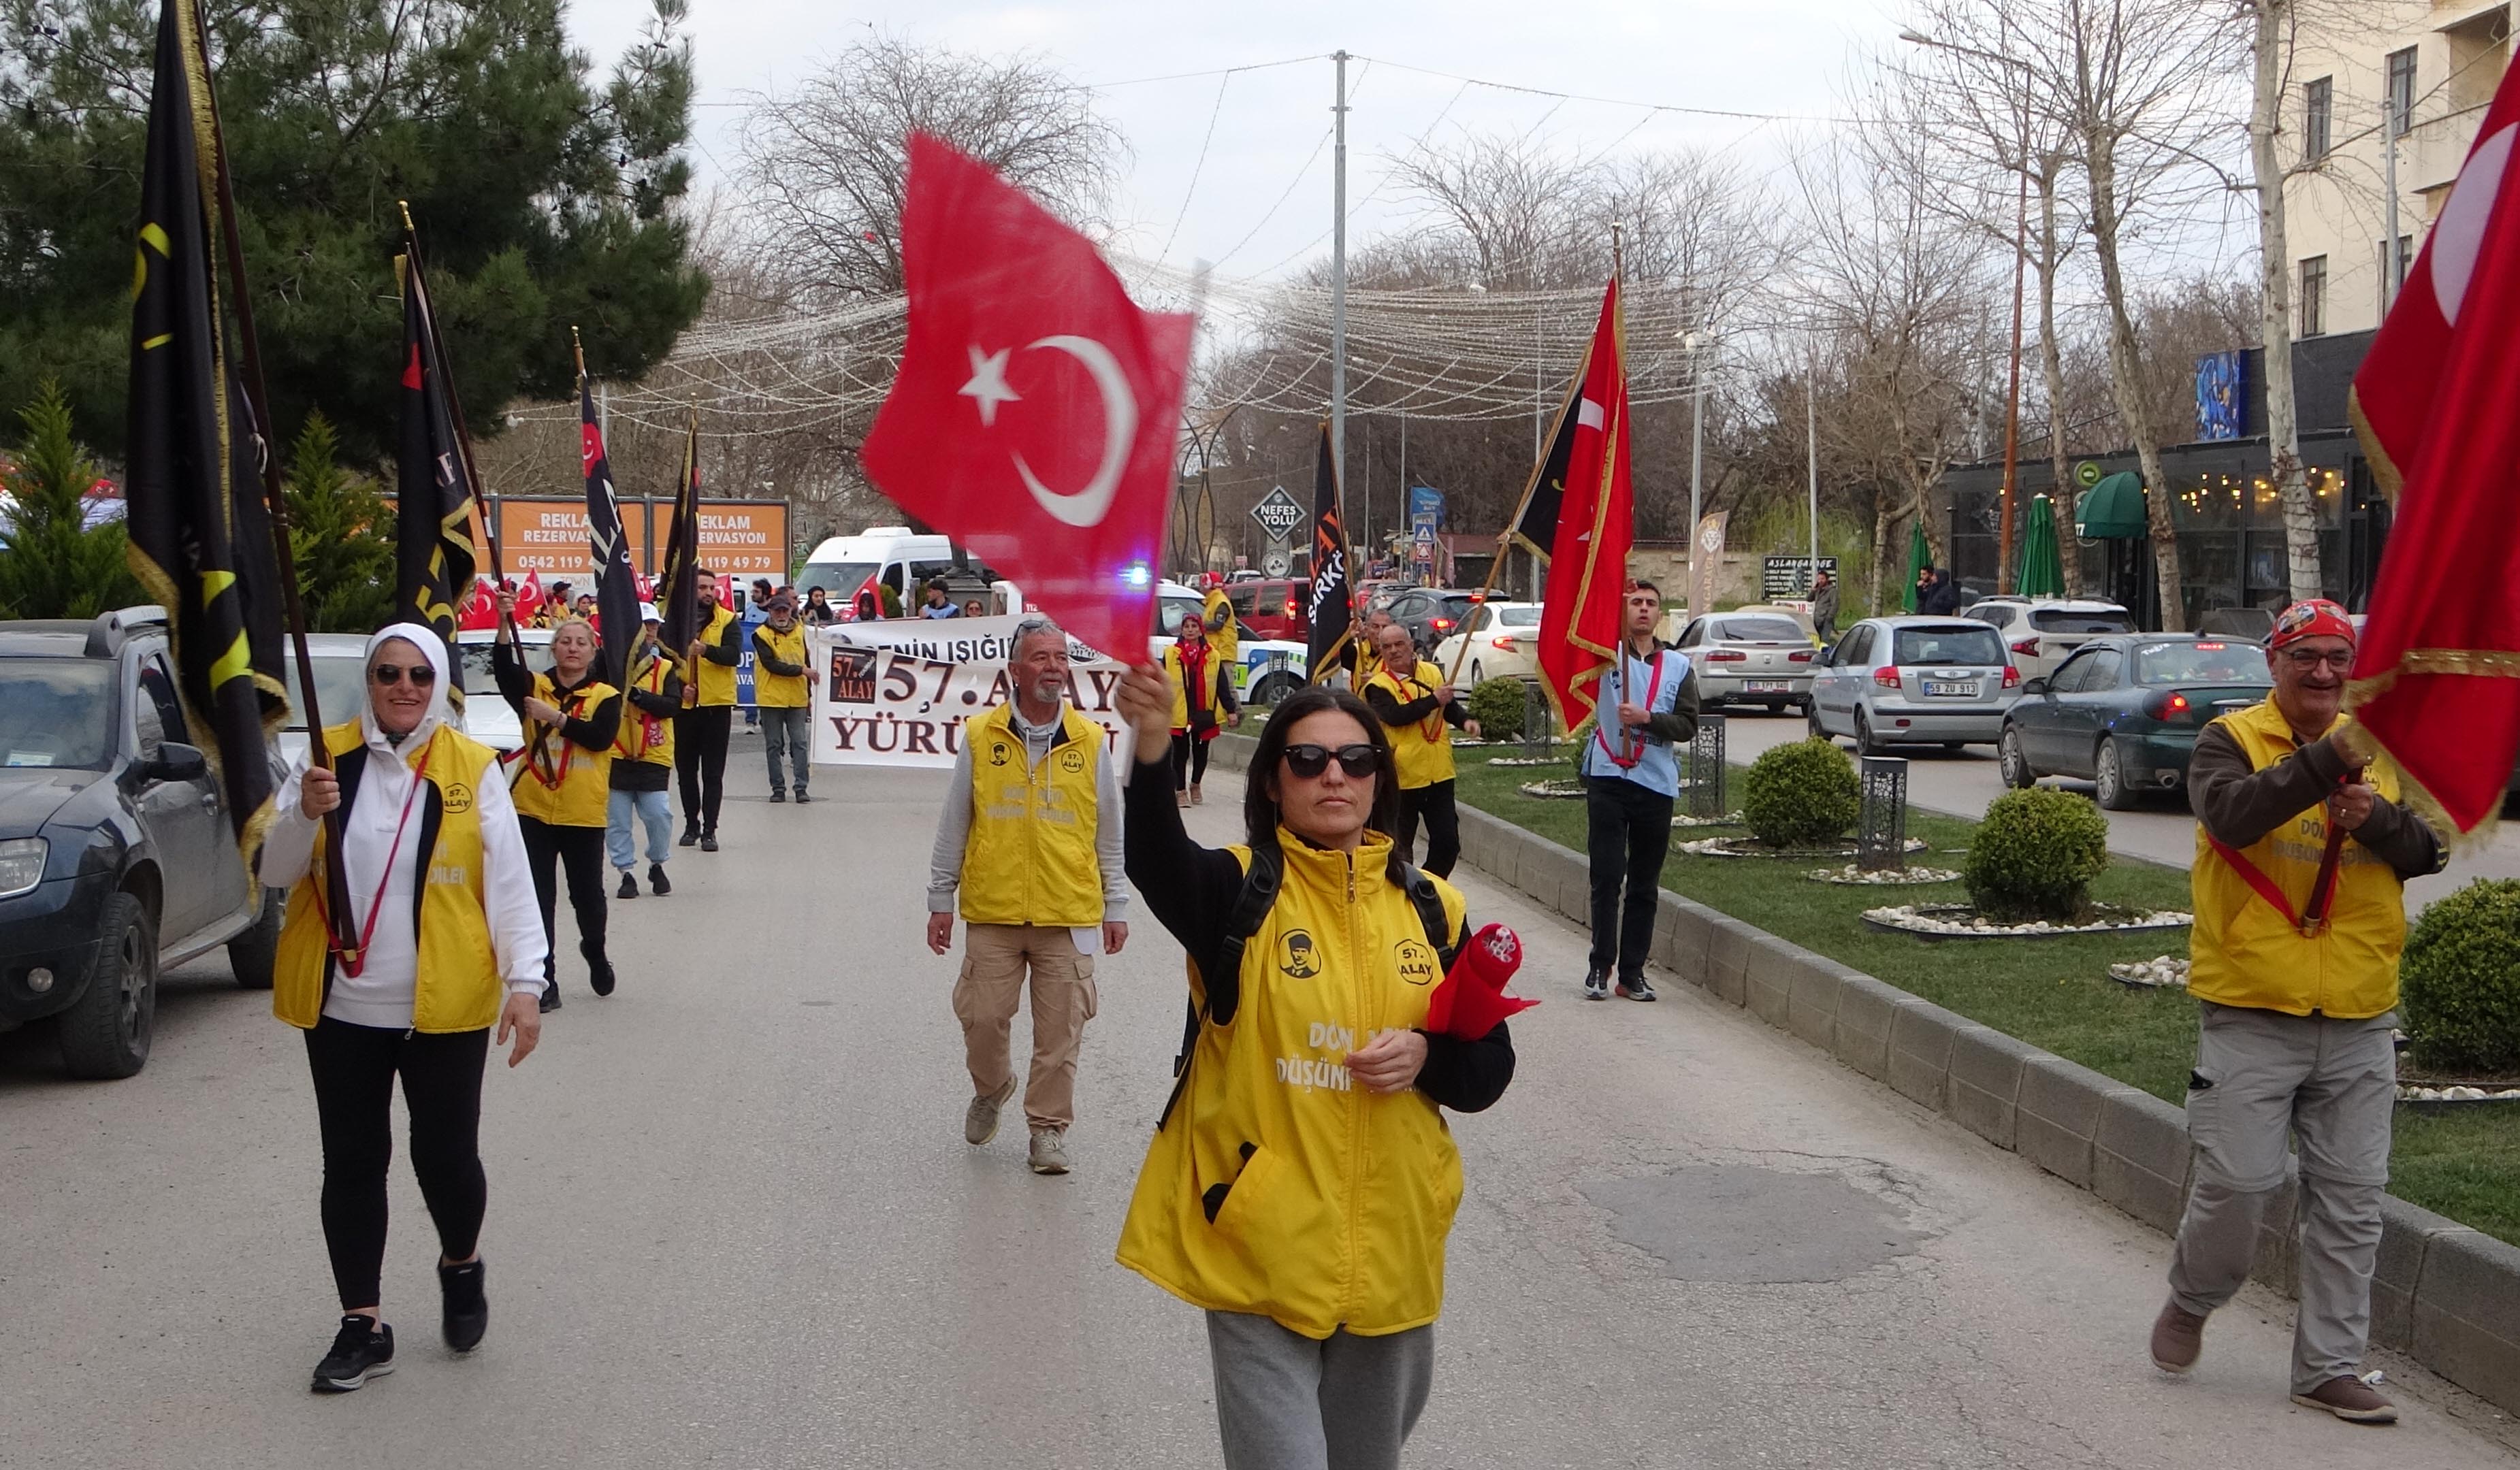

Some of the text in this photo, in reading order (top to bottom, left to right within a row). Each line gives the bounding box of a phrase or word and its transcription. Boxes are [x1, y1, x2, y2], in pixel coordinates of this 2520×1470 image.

[1261, 505, 1296, 515] NEFES
[540, 513, 591, 528] REKLA
[699, 515, 750, 529] EKLAM
[1263, 515, 1294, 525] YOLU
[523, 530, 592, 543] REZERVAS
[699, 532, 766, 544] ERVASYON
[518, 555, 555, 568] 0542
[560, 555, 583, 568] 119
[707, 556, 728, 568] 119
[732, 556, 749, 568] 49
[754, 556, 771, 568] 79
[1767, 559, 1833, 568] ASLANGAGE
[948, 634, 1012, 664] IŞIĞI
[833, 656, 858, 678] 57.
[883, 655, 978, 705] 57.
[982, 669, 1120, 712] AAY
[1931, 684, 1975, 693] 59 ZU 913
[838, 681, 875, 699] ALAY
[449, 789, 464, 798] 57.
[1402, 948, 1424, 959] 57.
[1400, 964, 1432, 975] ALAY
